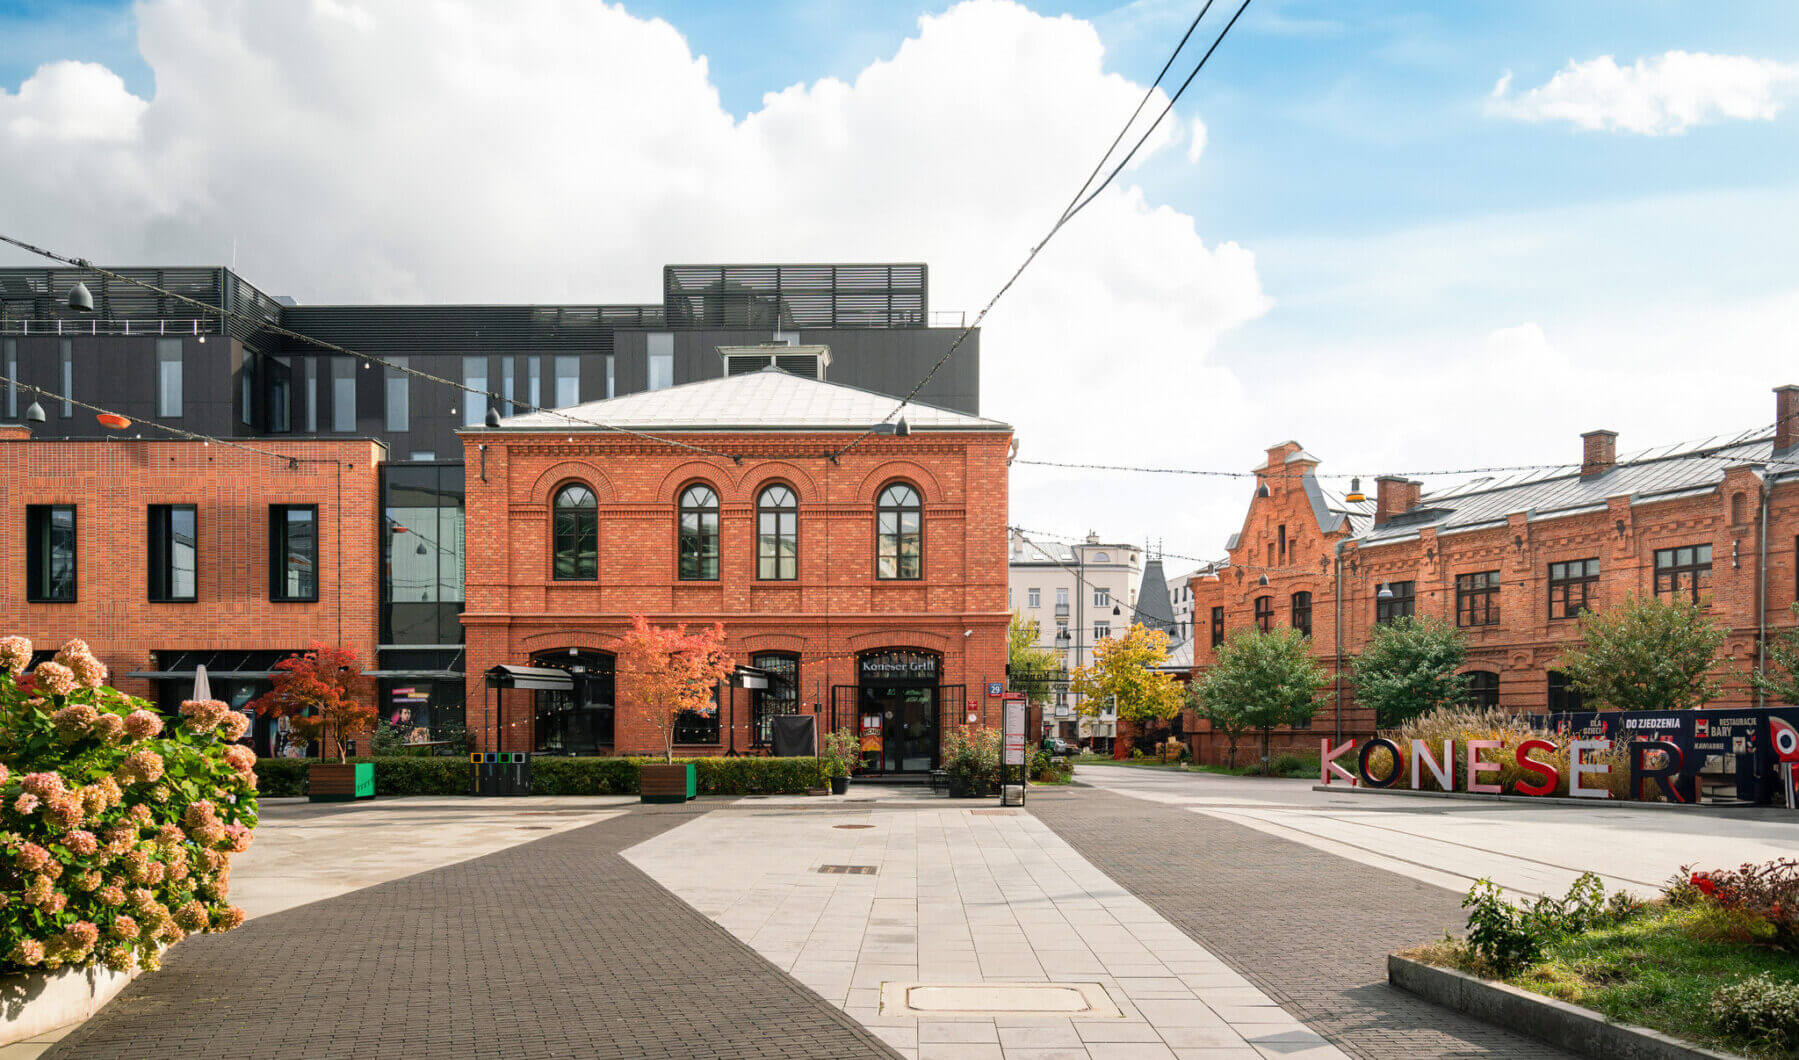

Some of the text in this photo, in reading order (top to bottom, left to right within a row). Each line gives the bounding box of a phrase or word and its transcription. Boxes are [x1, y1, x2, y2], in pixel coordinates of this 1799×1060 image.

[863, 660, 935, 671] Koneser Grill
[991, 685, 1000, 694] 29
[1625, 718, 1681, 729] DO ZJEDZENIA
[1711, 726, 1733, 737] BARY
[1320, 738, 1685, 802] KONESER
